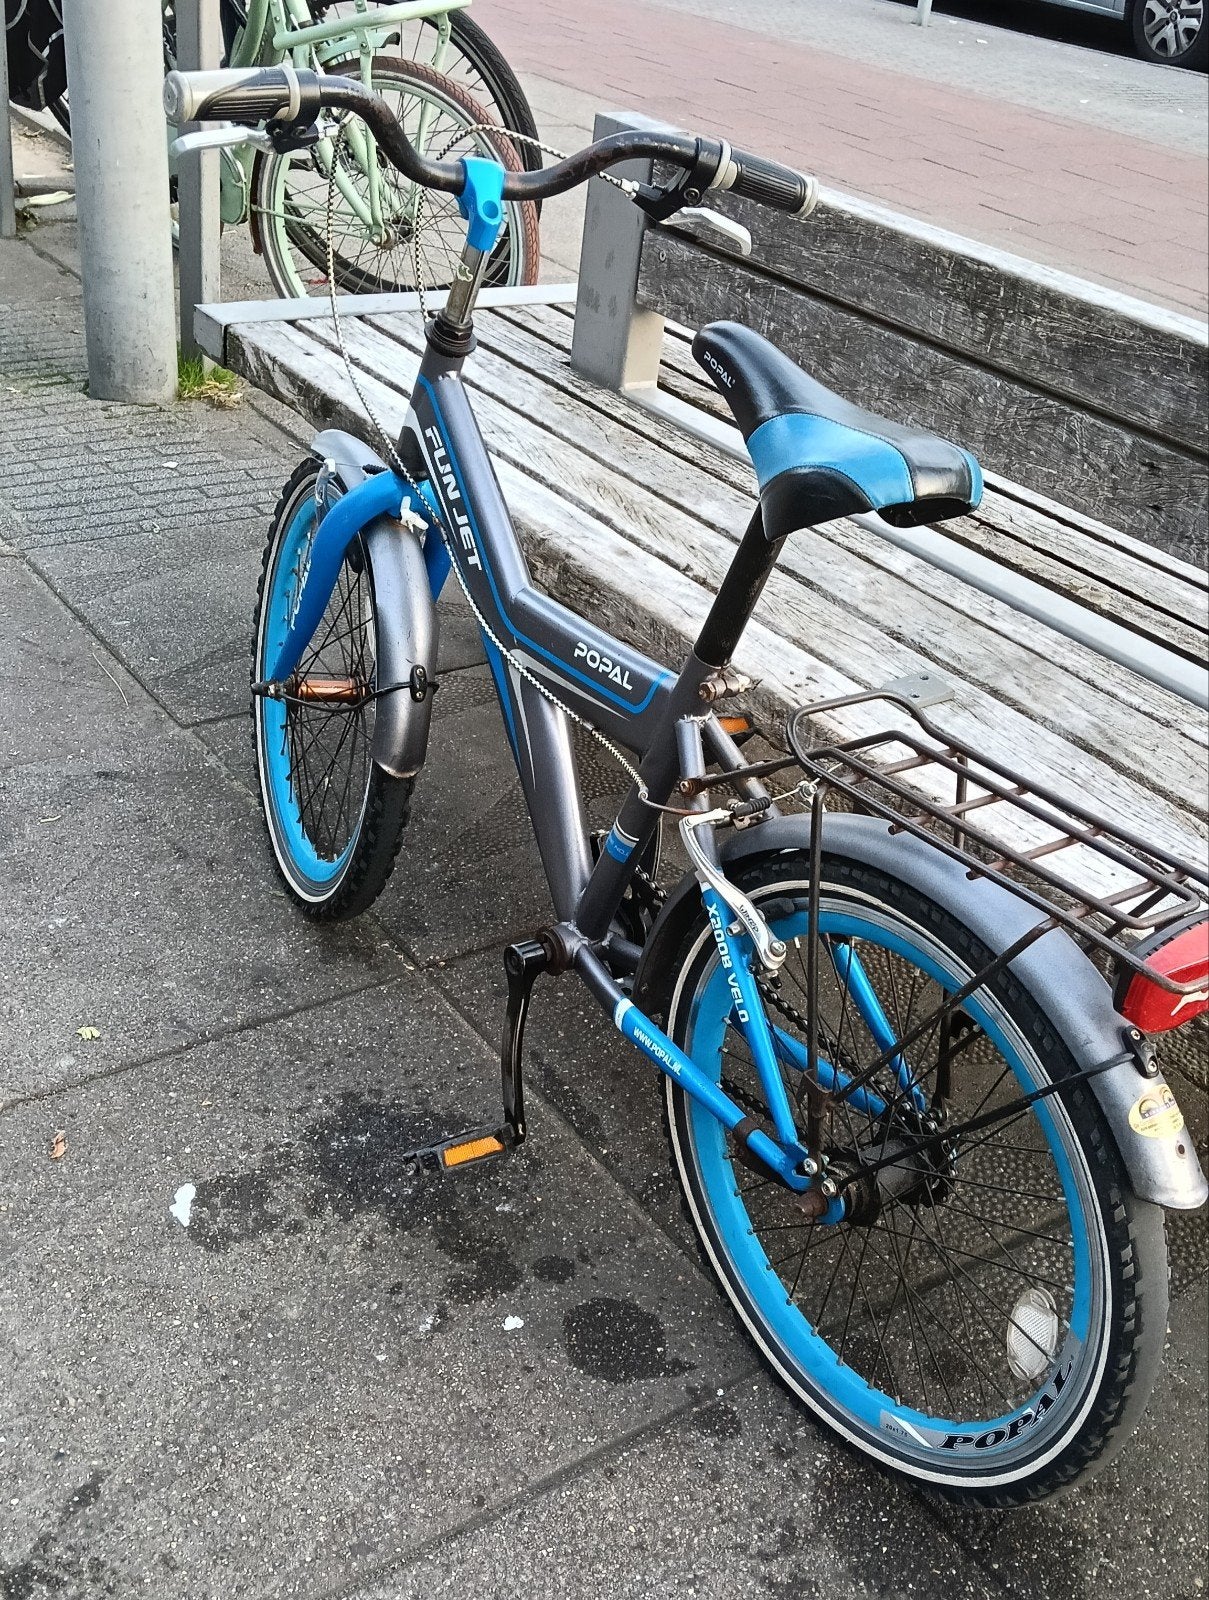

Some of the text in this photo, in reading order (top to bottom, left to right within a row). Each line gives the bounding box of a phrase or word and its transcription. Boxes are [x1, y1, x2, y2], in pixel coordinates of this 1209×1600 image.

[704, 351, 732, 388] POPAL
[425, 426, 482, 570] FUN JET
[573, 642, 633, 691] POPAL
[727, 972, 750, 1023] VELO
[633, 1026, 682, 1076] WWW.POPAL.NL
[937, 1361, 1073, 1450] POPAL
